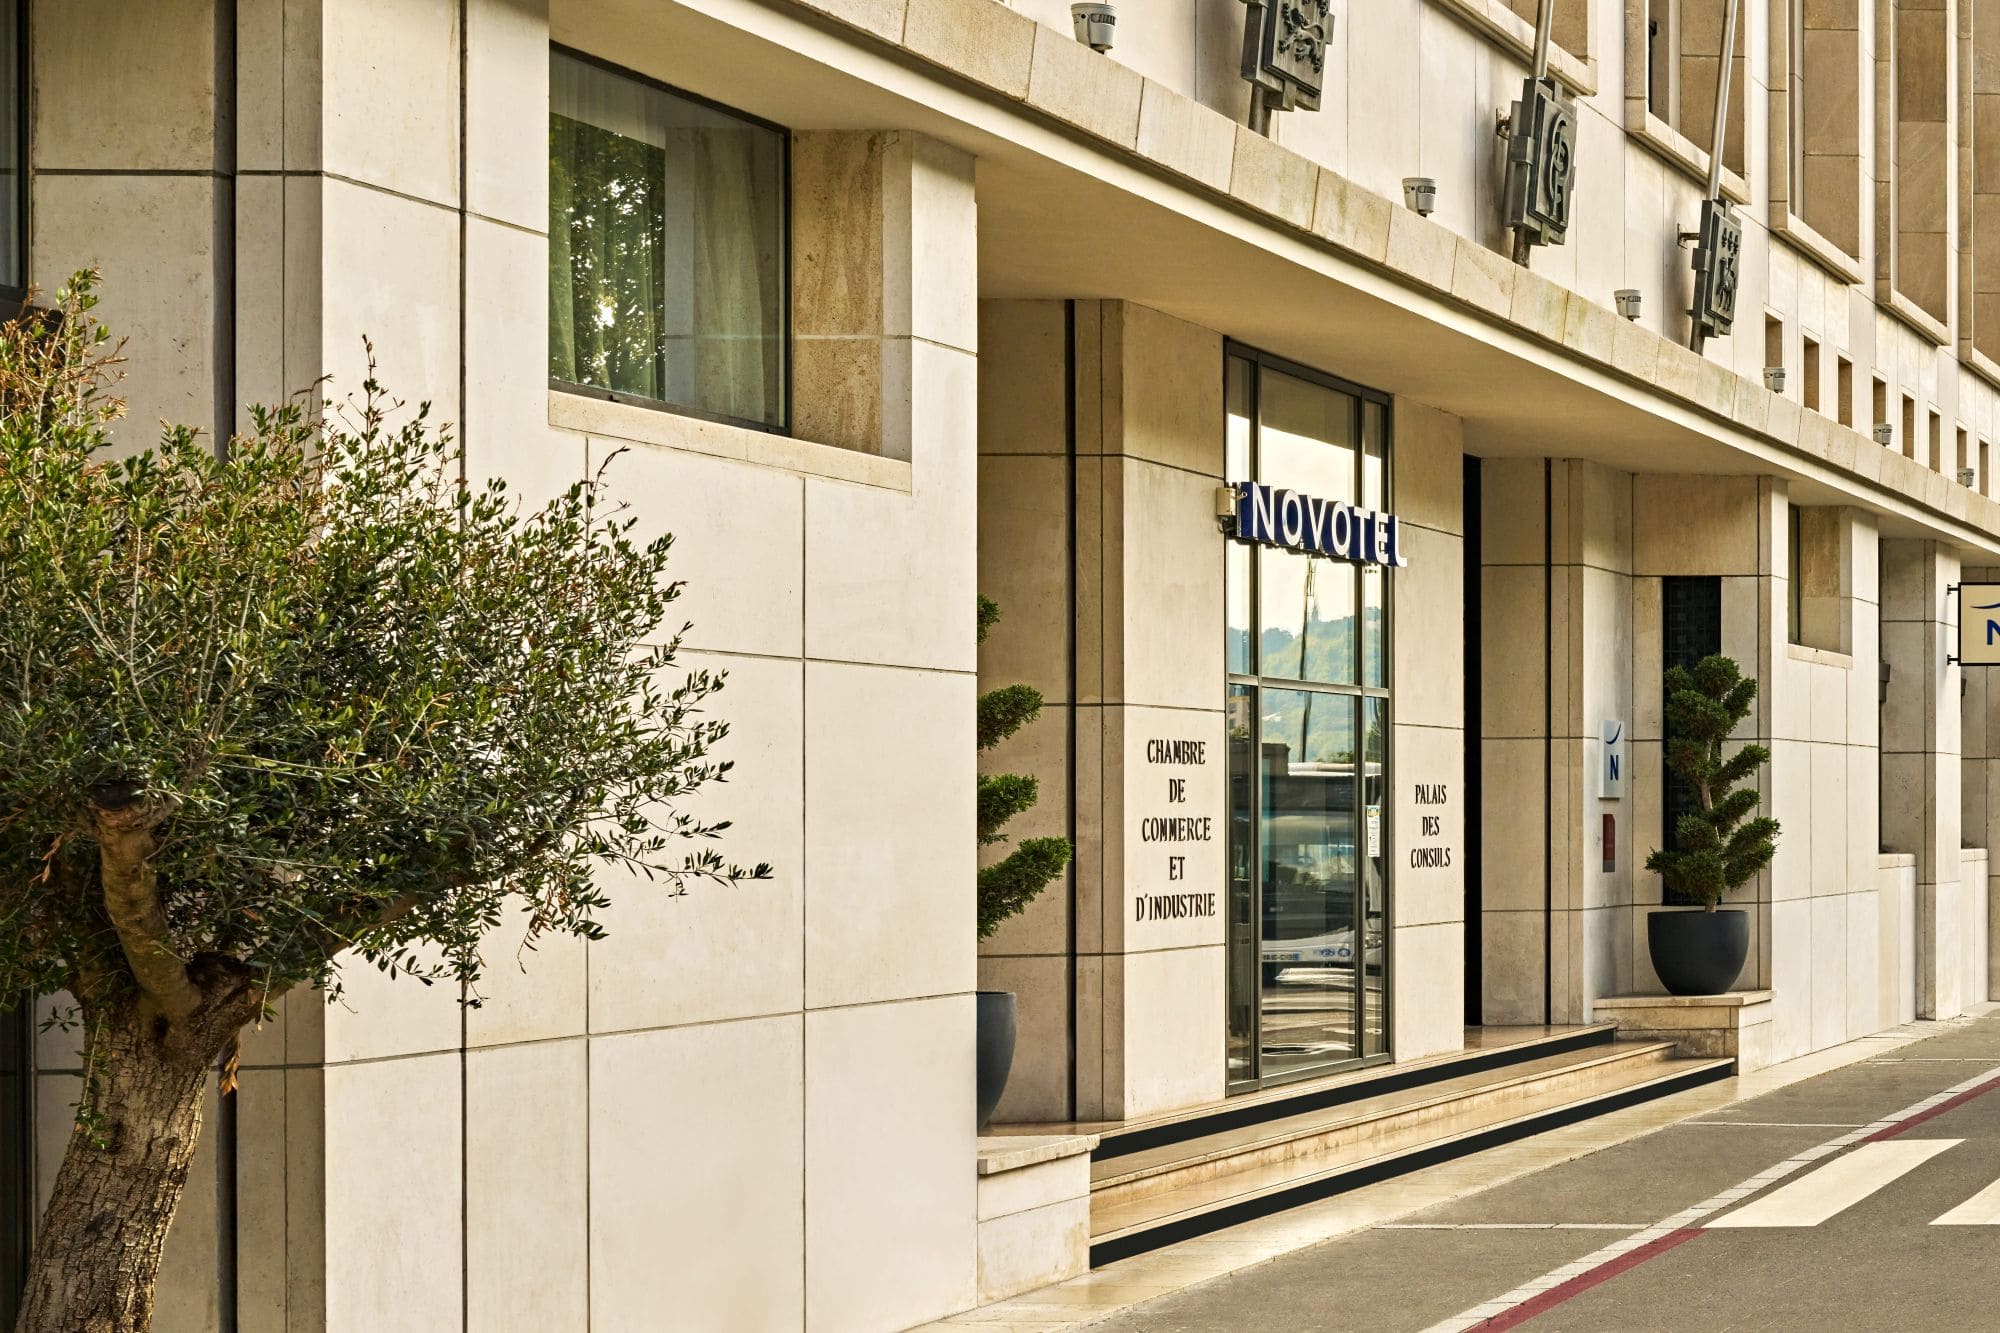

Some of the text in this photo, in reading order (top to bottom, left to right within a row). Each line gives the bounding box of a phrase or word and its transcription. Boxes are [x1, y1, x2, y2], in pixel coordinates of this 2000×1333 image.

[1243, 481, 1408, 568] NOVOTEL
[1147, 739, 1206, 765] CHAMBRE
[1610, 754, 1619, 781] N
[1168, 779, 1186, 803] DE
[1414, 783, 1447, 805] PALAIS
[1141, 816, 1212, 842] COMMERCE
[1422, 815, 1440, 836] DES
[1169, 856, 1186, 881] ET
[1410, 847, 1451, 869] CONSULS
[1135, 892, 1216, 922] D'INDUSTRIE
